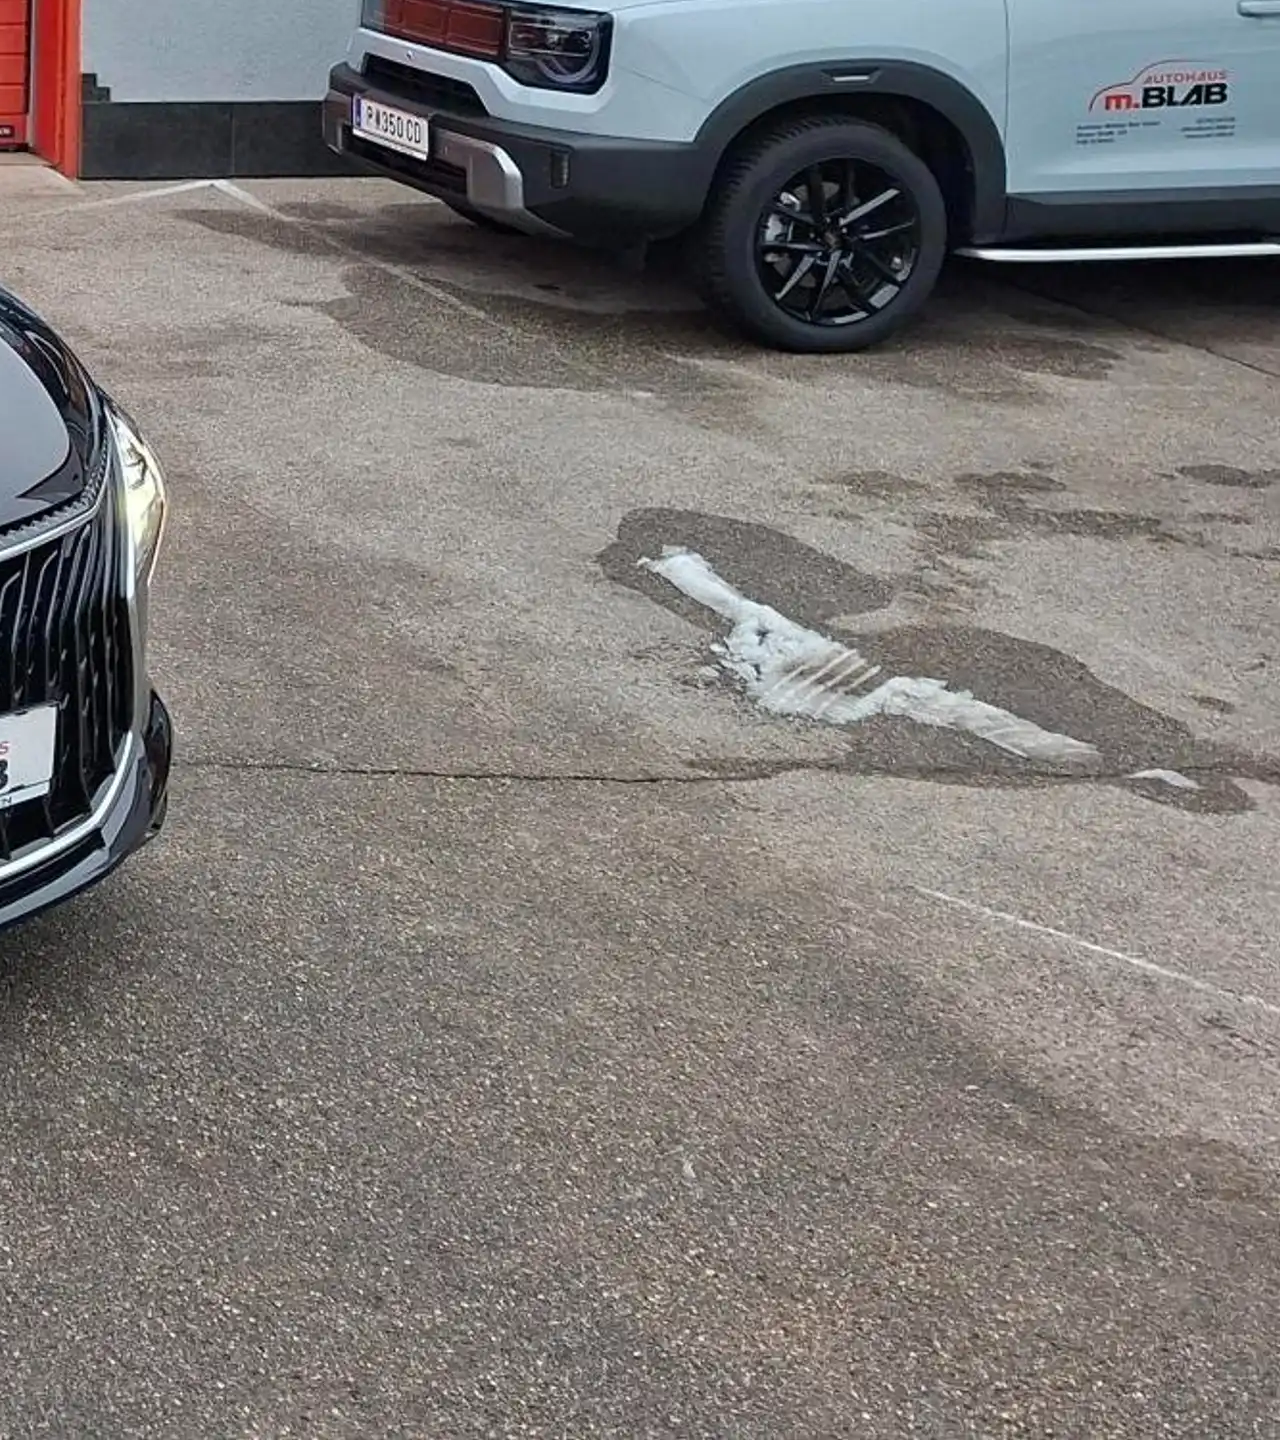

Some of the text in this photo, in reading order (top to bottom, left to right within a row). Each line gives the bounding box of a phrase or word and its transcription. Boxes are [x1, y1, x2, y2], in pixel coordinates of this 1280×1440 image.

[1144, 70, 1228, 84] AUTOHAUS
[1105, 83, 1228, 111] m.BLAB
[382, 111, 404, 138] 350
[407, 119, 421, 143] CD
